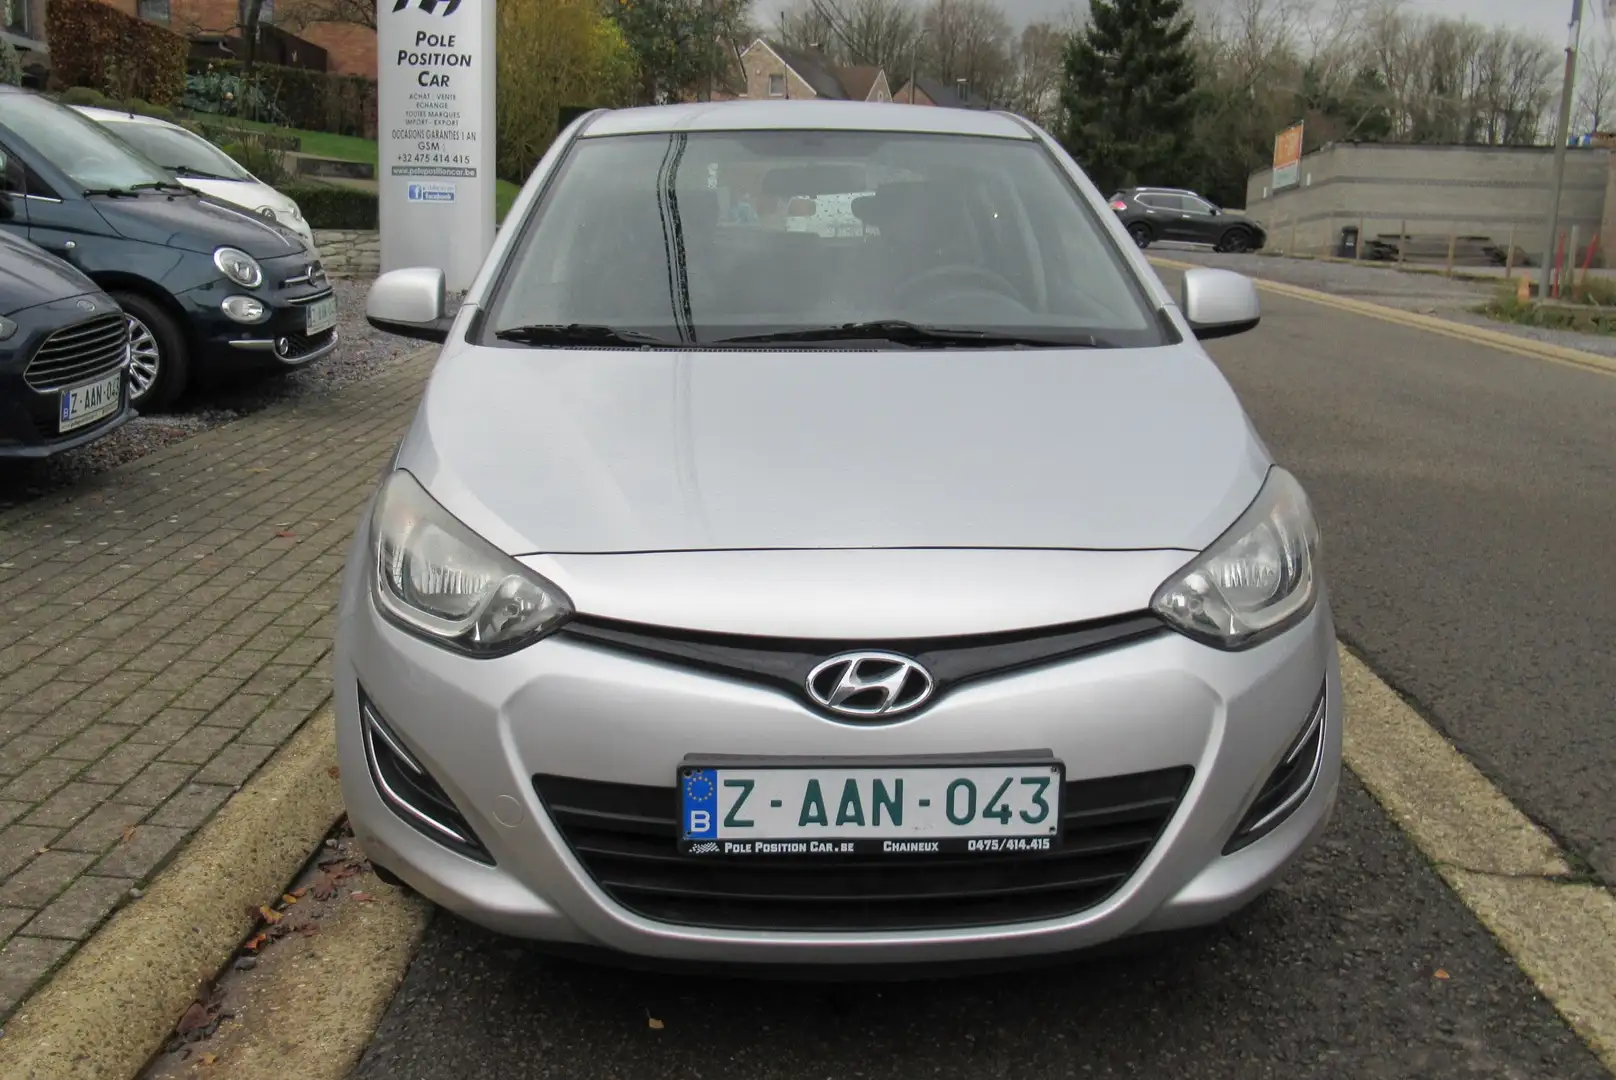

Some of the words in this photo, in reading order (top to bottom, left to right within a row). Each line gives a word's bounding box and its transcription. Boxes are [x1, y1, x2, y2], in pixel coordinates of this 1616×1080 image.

[415, 30, 456, 48] POLE
[397, 50, 472, 67] POSITION
[418, 71, 450, 87] CAR
[408, 92, 430, 100] ACHAT
[436, 93, 456, 101] VENTE
[405, 110, 426, 118] TOUTES
[427, 111, 460, 119] MARQUES
[405, 118, 428, 126] IMPORT
[391, 128, 425, 140] OCCASIONS
[466, 131, 476, 141] AN
[417, 141, 440, 151] GSM
[397, 153, 412, 163] +32
[414, 153, 430, 163] 475
[432, 154, 450, 164] 414
[452, 155, 470, 164] 415
[690, 810, 710, 833] B
[724, 841, 752, 853] POLE
[754, 841, 806, 853] POSITION
[883, 841, 939, 852] CHAINEUX
[967, 838, 1050, 852] 0475/414.415
